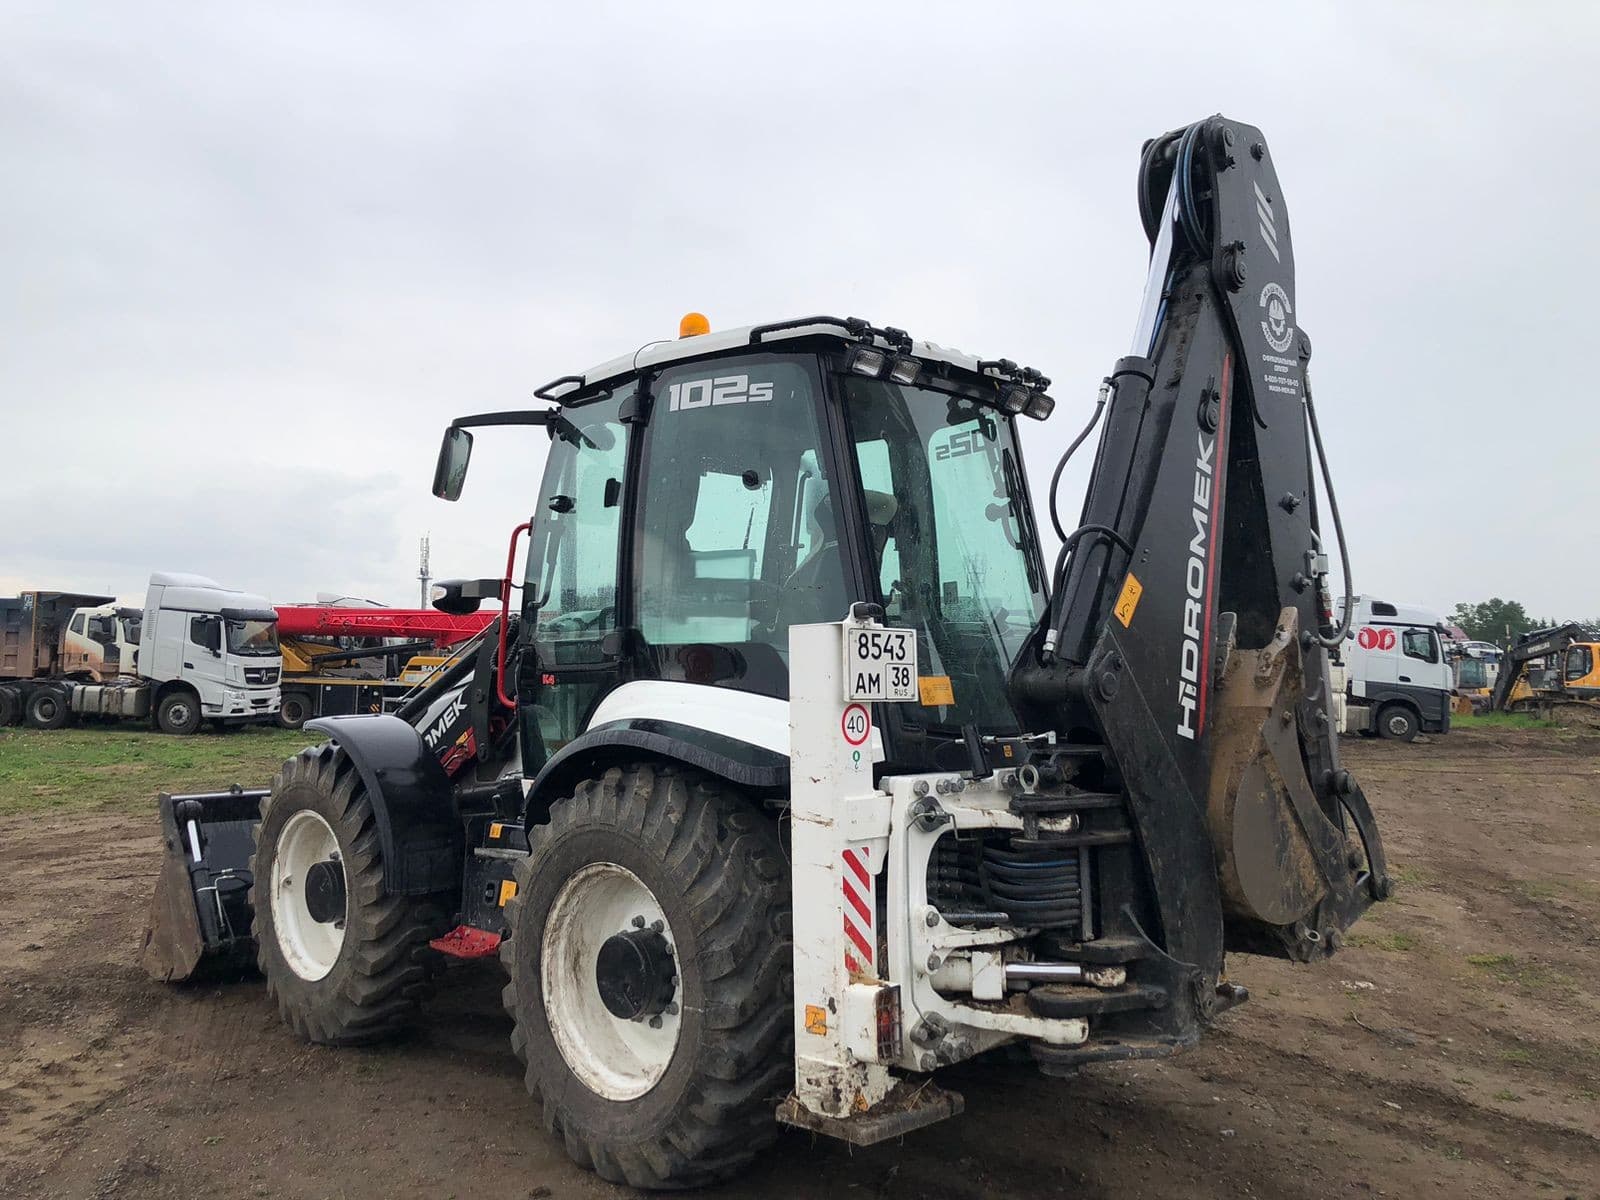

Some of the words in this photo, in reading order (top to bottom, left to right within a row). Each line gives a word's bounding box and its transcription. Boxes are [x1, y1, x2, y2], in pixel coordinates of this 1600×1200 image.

[858, 633, 906, 661] 8543
[855, 673, 881, 694] AM
[892, 667, 910, 687] 38
[894, 688, 908, 697] RUS
[847, 715, 865, 733] 40
